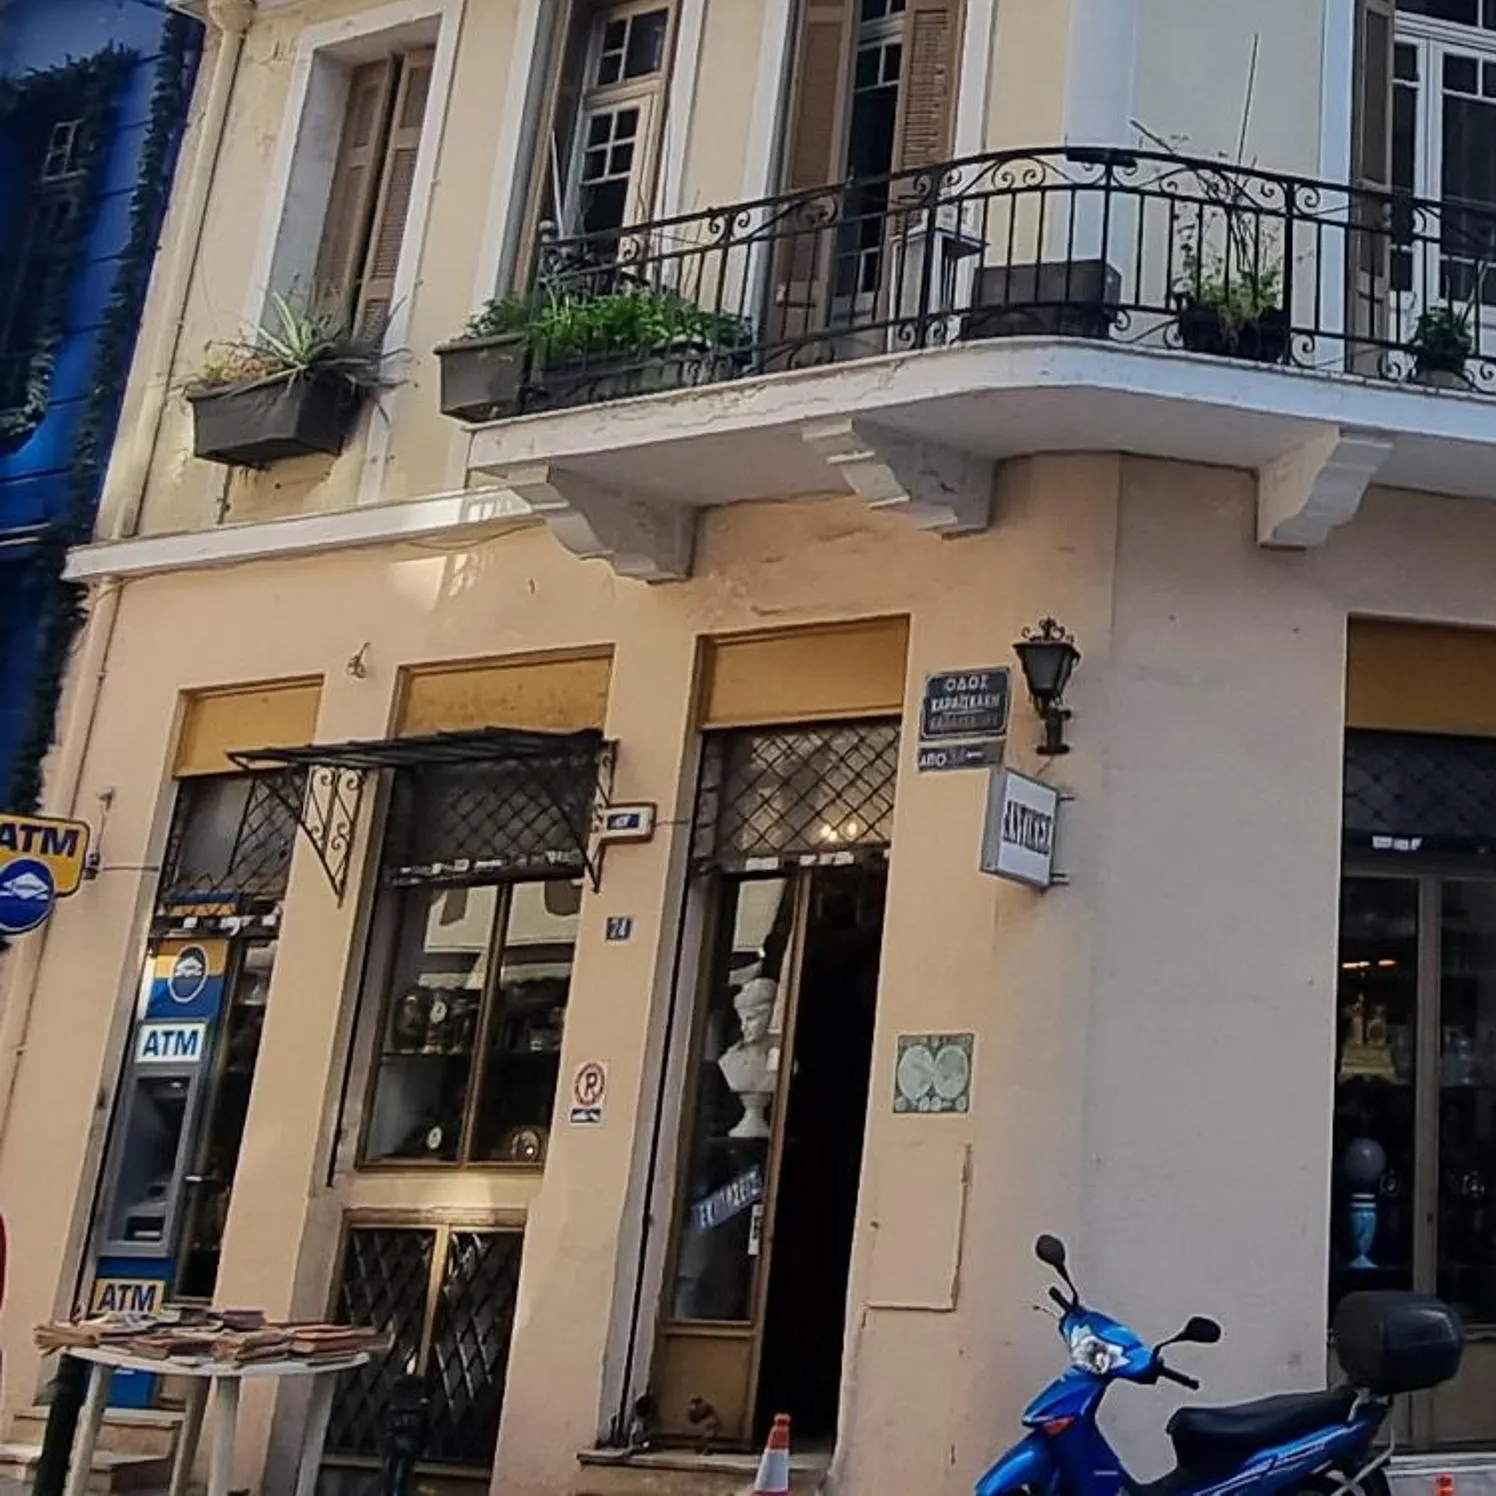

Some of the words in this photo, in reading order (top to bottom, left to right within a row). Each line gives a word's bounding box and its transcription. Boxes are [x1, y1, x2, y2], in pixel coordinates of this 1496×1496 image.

[945, 674, 988, 692] ΟΔΟΣ
[0, 822, 80, 858] ATM
[142, 1027, 200, 1057] ATM
[96, 1282, 158, 1312] ATM
